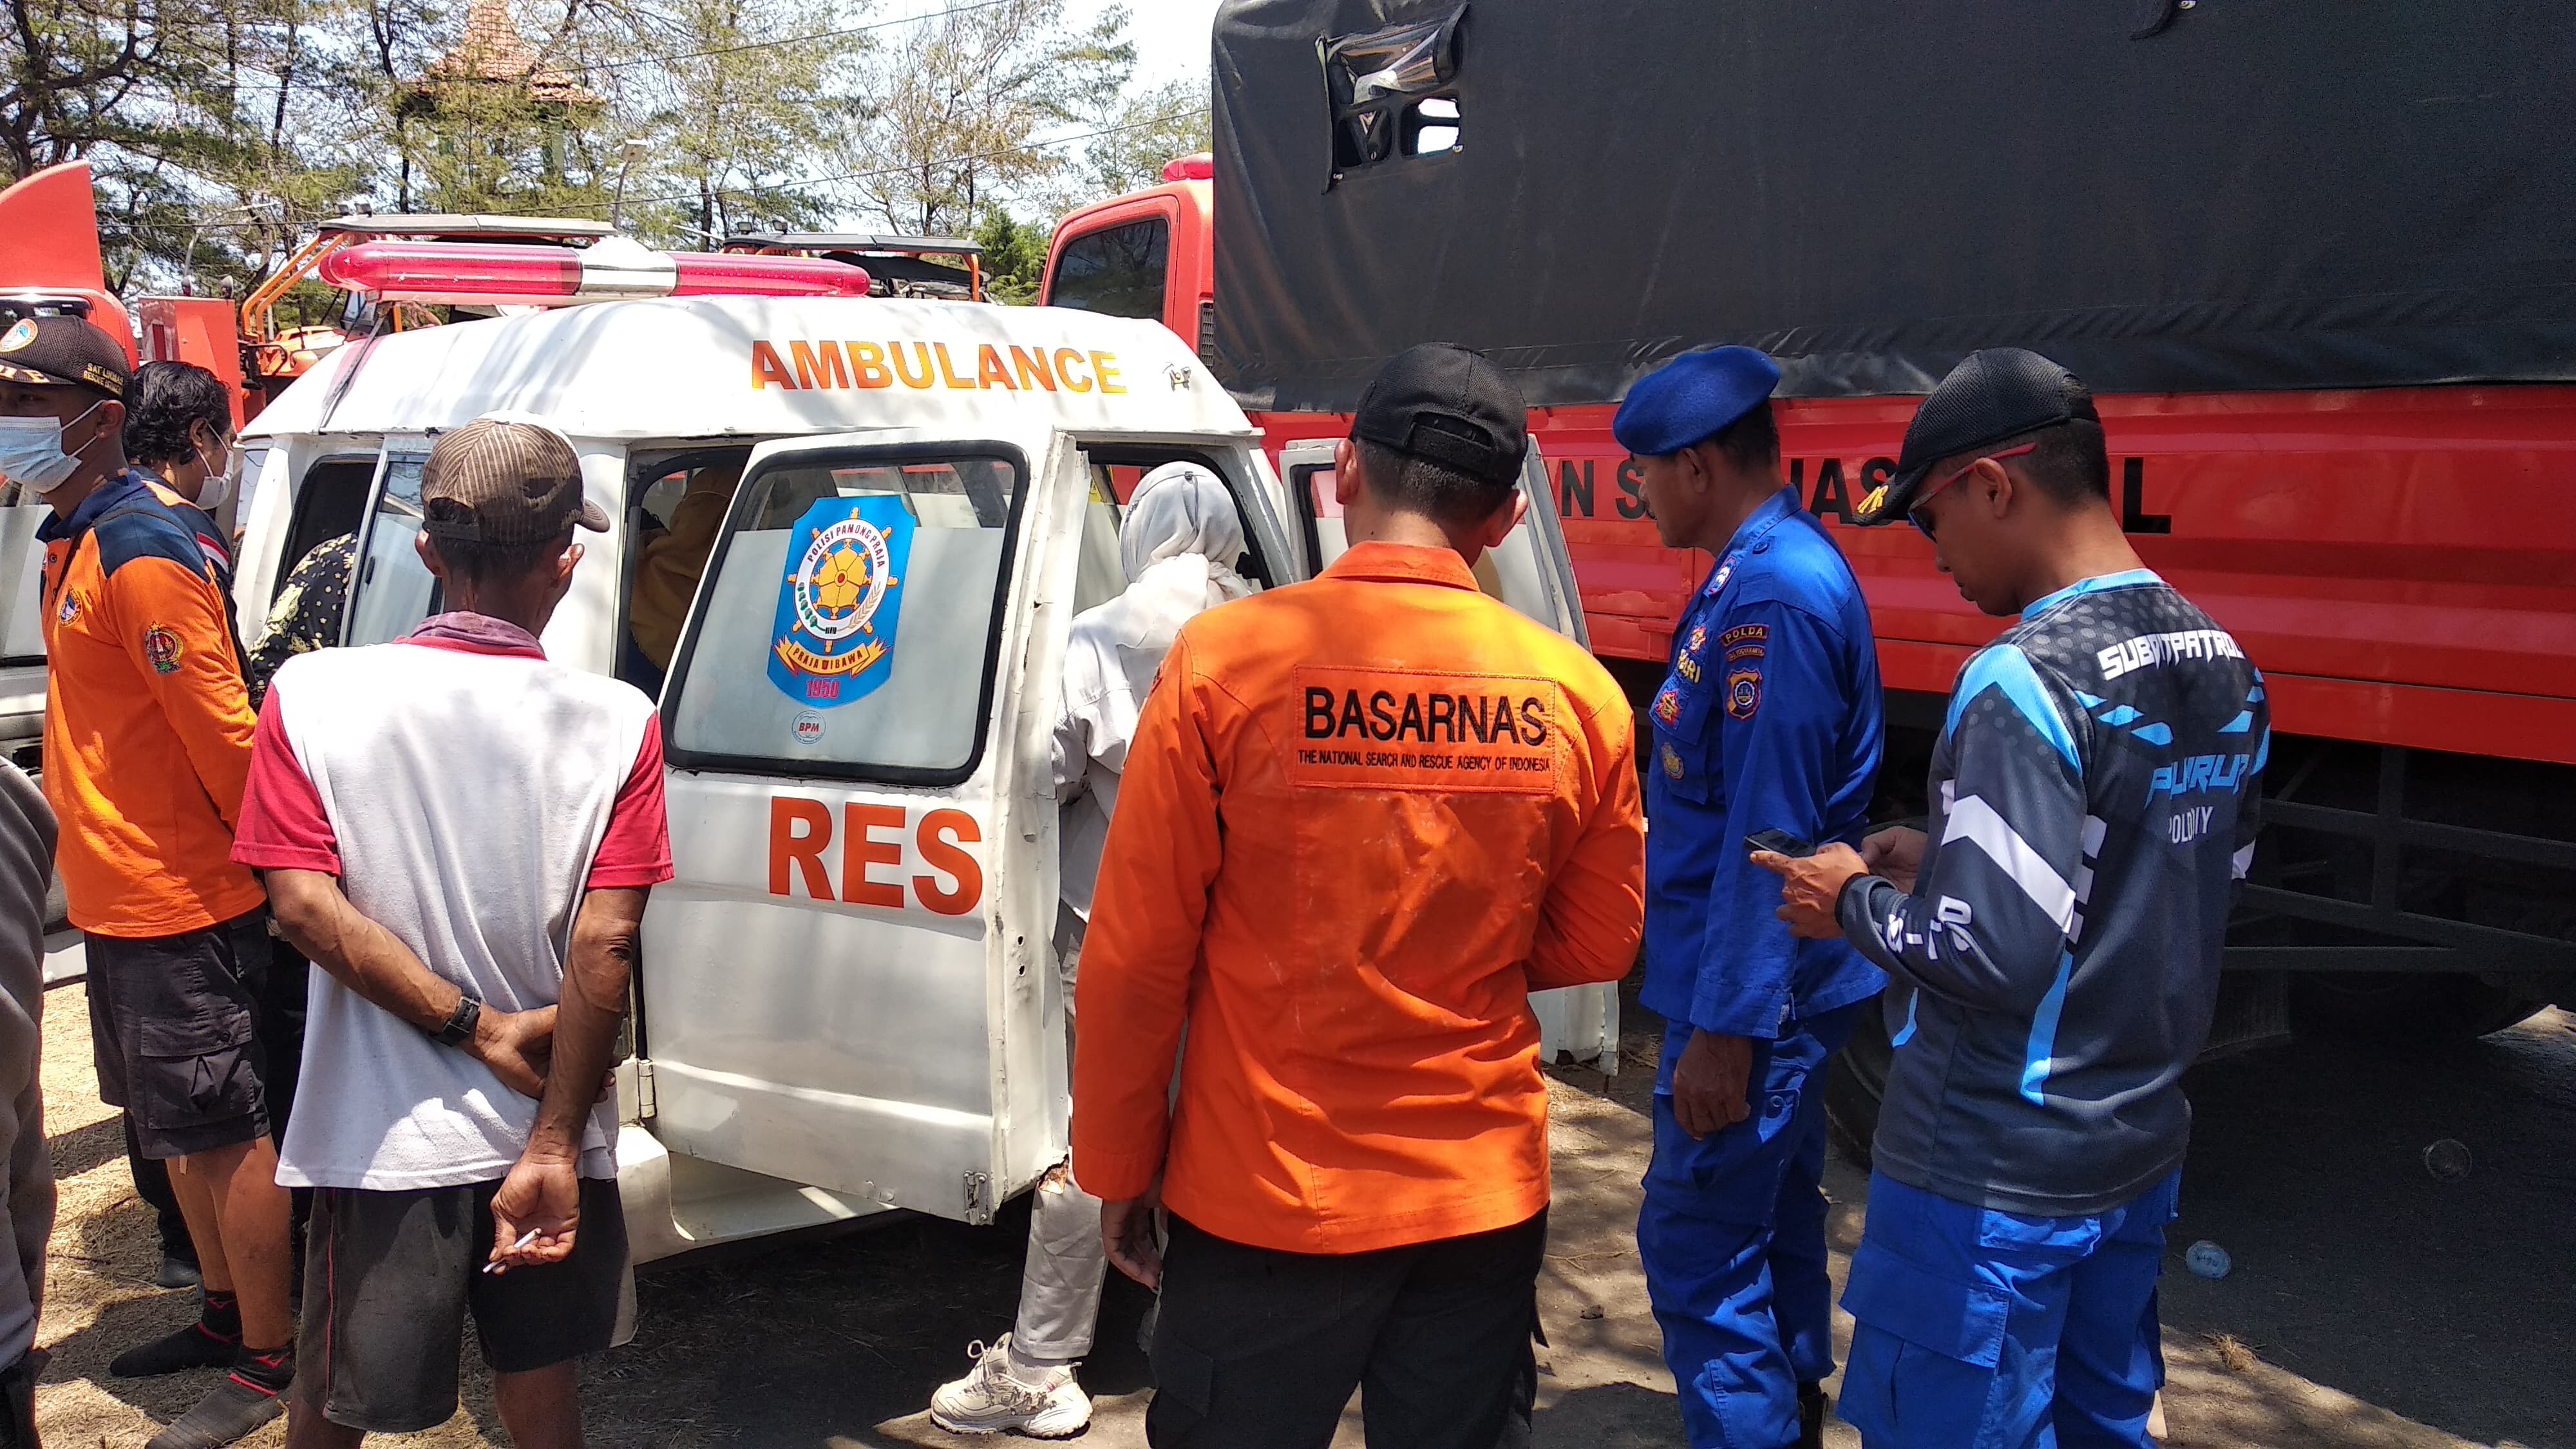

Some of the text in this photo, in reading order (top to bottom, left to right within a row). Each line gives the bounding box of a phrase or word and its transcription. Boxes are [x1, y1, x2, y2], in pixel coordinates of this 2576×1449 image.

[752, 340, 1127, 393] AMBULANCE
[807, 531, 833, 562] POLISI
[836, 524, 872, 538] PAMONG
[1725, 627, 1763, 643] POLDA
[793, 647, 819, 668] PRAJA
[806, 679, 840, 698] 1950
[799, 723, 819, 732] BPM
[1305, 687, 1546, 746] BASARNAS
[1298, 750, 1550, 772] THE NATIONAL SEARCH AND RESCUE AGENCY OF INDONESIA
[770, 795, 983, 915] RES
